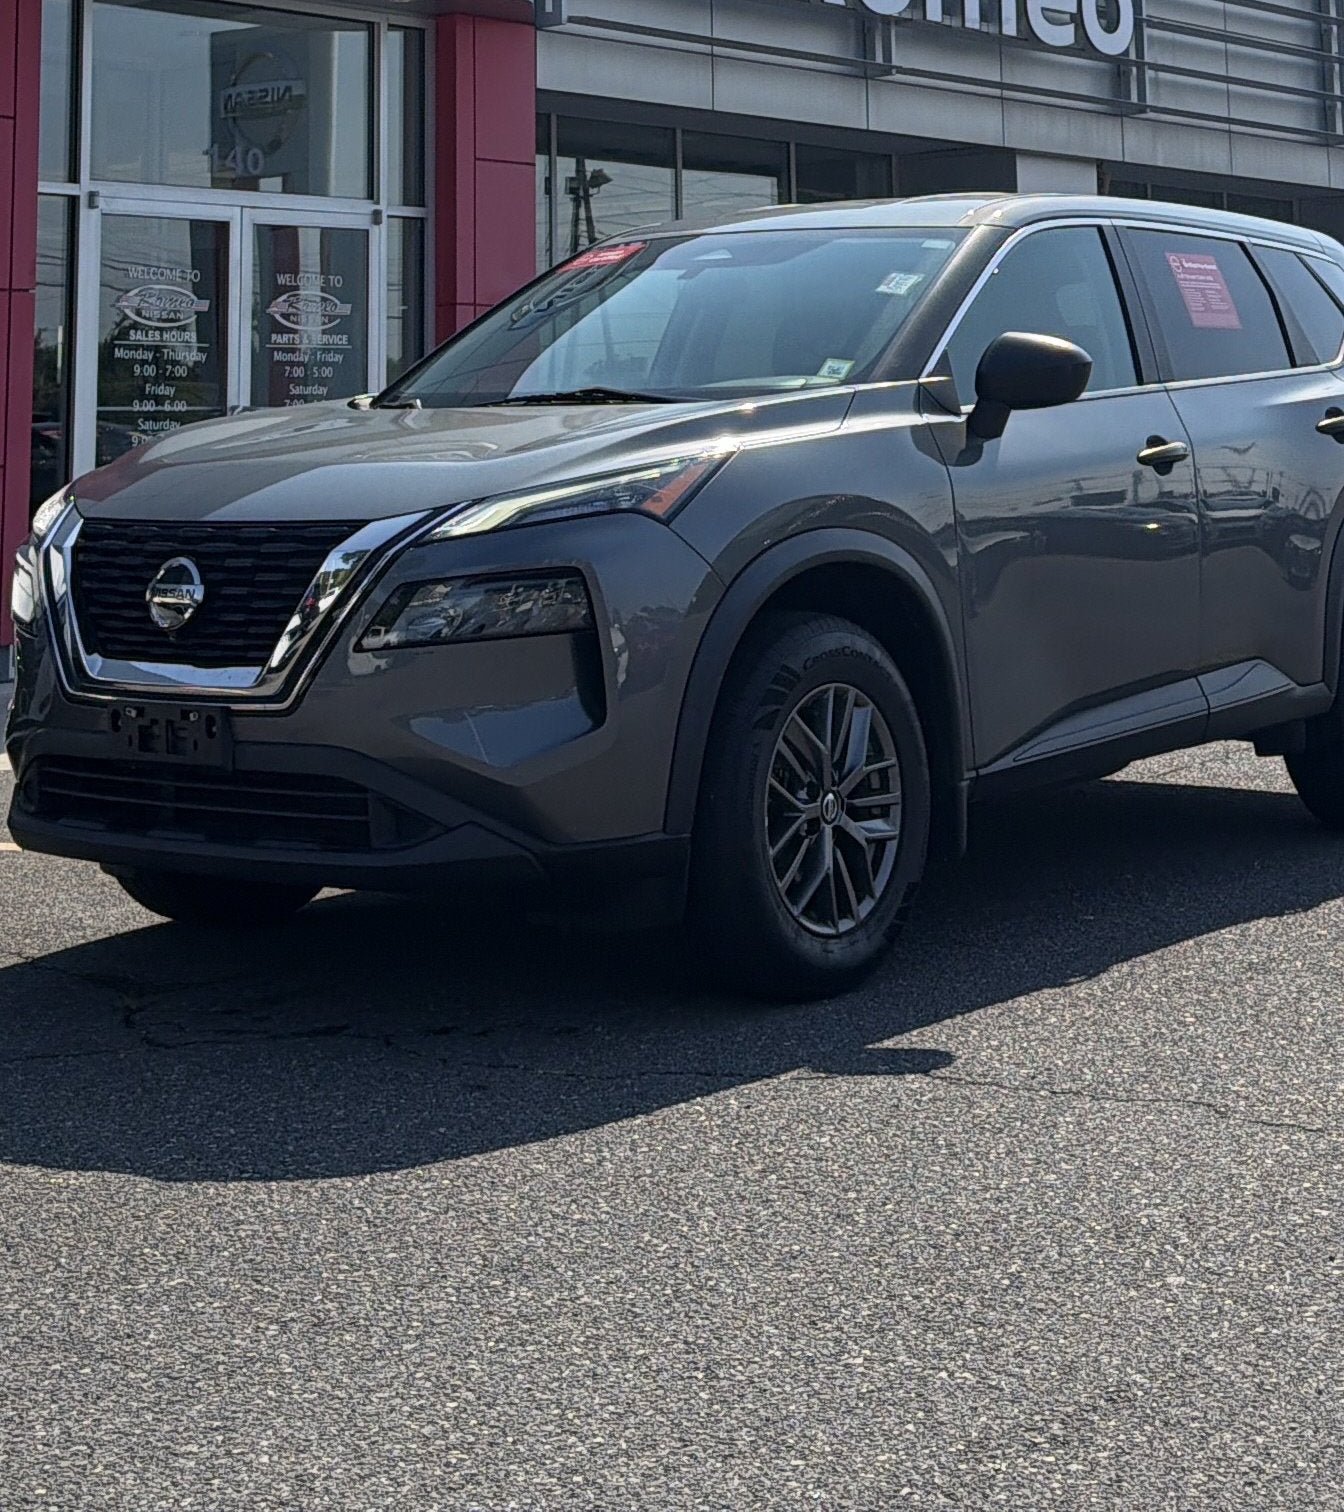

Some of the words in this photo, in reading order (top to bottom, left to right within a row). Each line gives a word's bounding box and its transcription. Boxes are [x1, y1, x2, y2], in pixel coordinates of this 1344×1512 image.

[128, 267, 182, 281] WELCOME
[185, 269, 200, 282] TO
[276, 273, 326, 287] WELCOME
[328, 275, 343, 287] TO
[141, 309, 184, 320] NISSAN
[289, 314, 329, 324] NIN
[129, 329, 160, 340] SALES
[163, 330, 196, 342] HOURS
[271, 333, 300, 344] PARTS
[114, 348, 154, 362] Monday
[162, 348, 207, 364] Thursday
[273, 350, 310, 364] Monday
[317, 350, 344, 364] Friday
[133, 364, 156, 377] 9:00
[165, 365, 188, 377] 7:00
[284, 366, 305, 377] 7:00
[312, 366, 333, 378] 5:00
[145, 383, 176, 397] Friday
[289, 383, 328, 396] Saturday
[133, 399, 156, 412] 9:00
[164, 399, 187, 412] 6:00
[137, 418, 181, 430] Saturday
[151, 586, 196, 601] NISSAN
